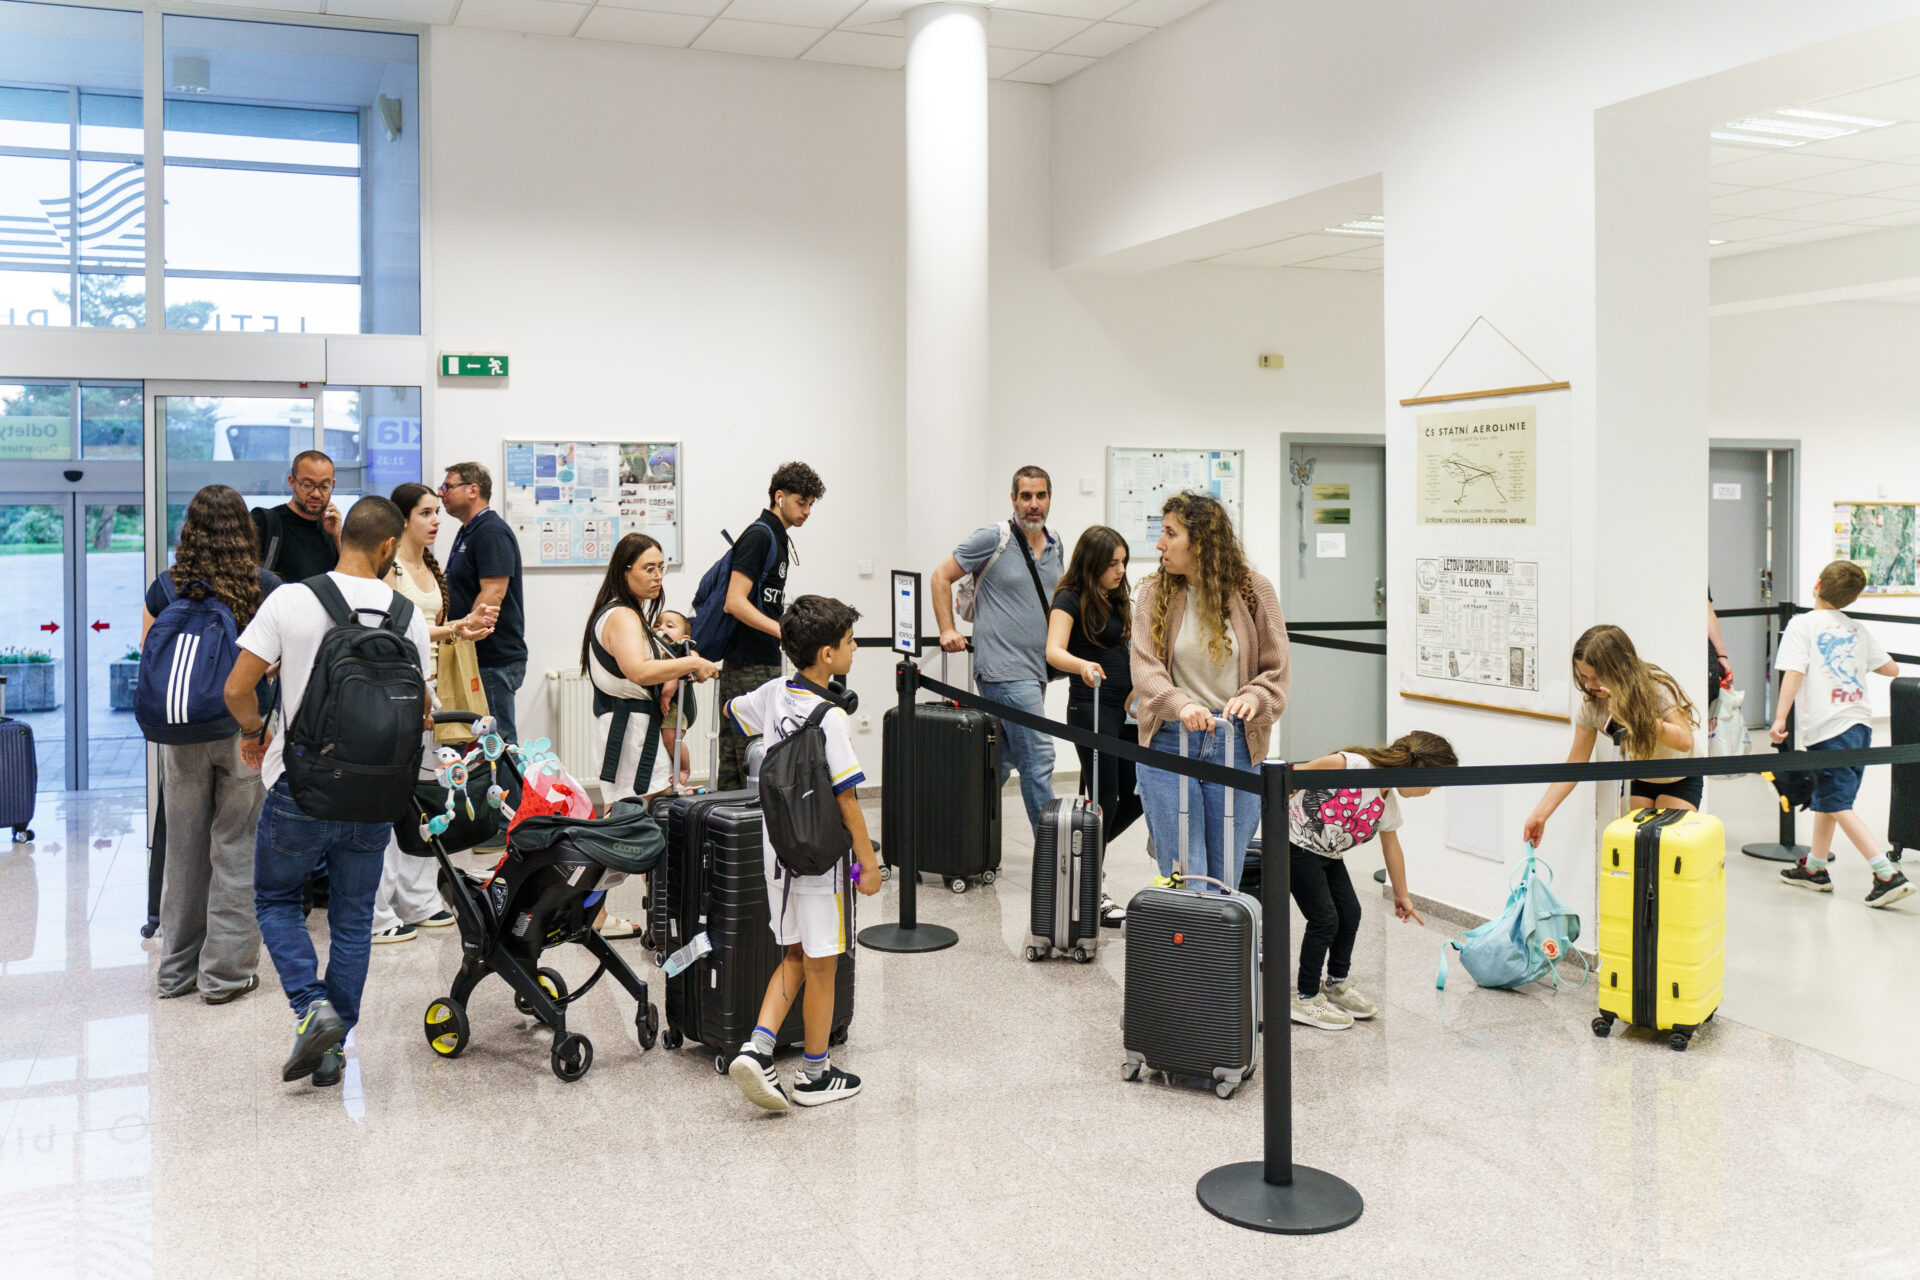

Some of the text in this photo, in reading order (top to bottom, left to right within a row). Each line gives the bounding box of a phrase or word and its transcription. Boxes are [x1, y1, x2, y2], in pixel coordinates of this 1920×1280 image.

[1425, 421, 1526, 437] ČS STÁTNÍ AEROLINIE
[1458, 577, 1492, 589] ALCRON
